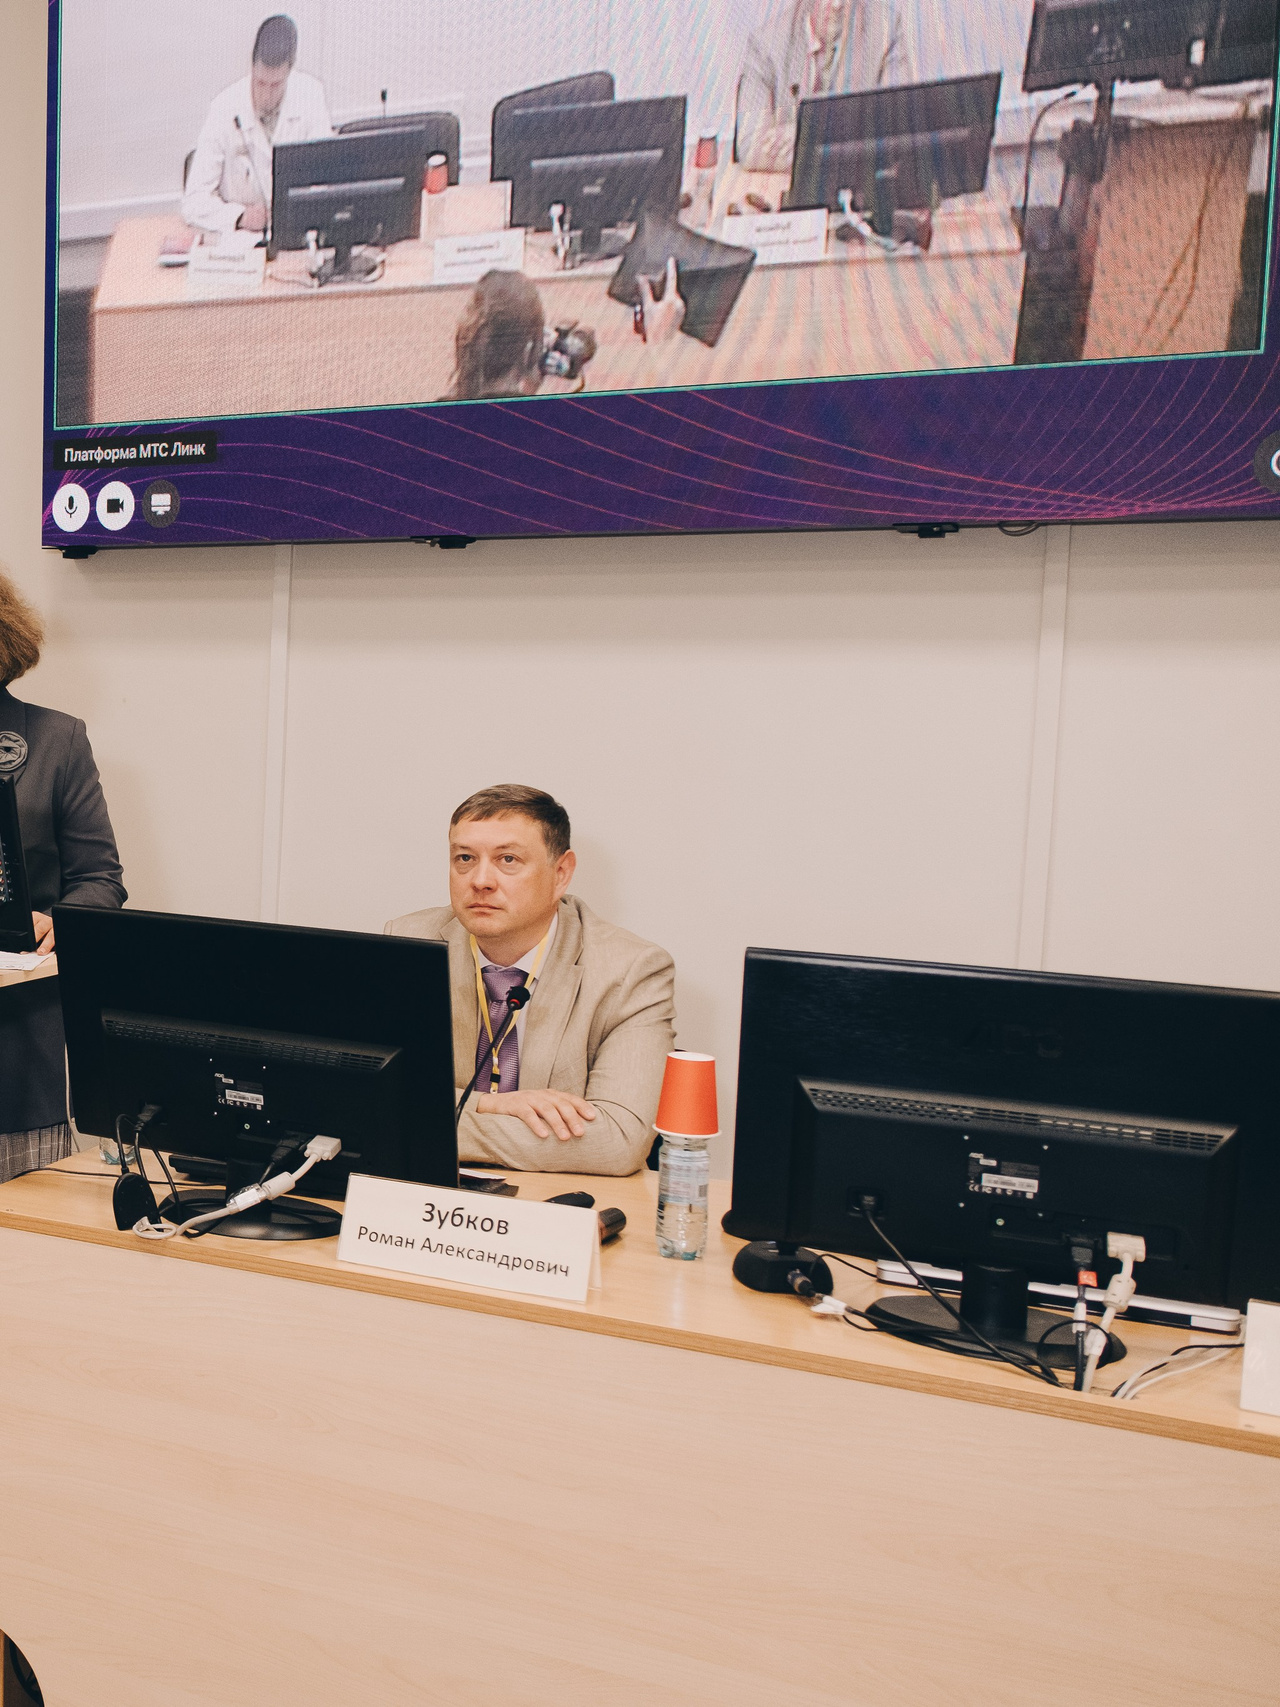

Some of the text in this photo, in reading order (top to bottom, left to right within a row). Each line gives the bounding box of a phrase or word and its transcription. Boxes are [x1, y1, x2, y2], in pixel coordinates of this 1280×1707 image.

[64, 441, 206, 463] Платформа МТС Линк
[422, 1203, 509, 1235] Зубков
[357, 1226, 569, 1277] Роман Александрович
